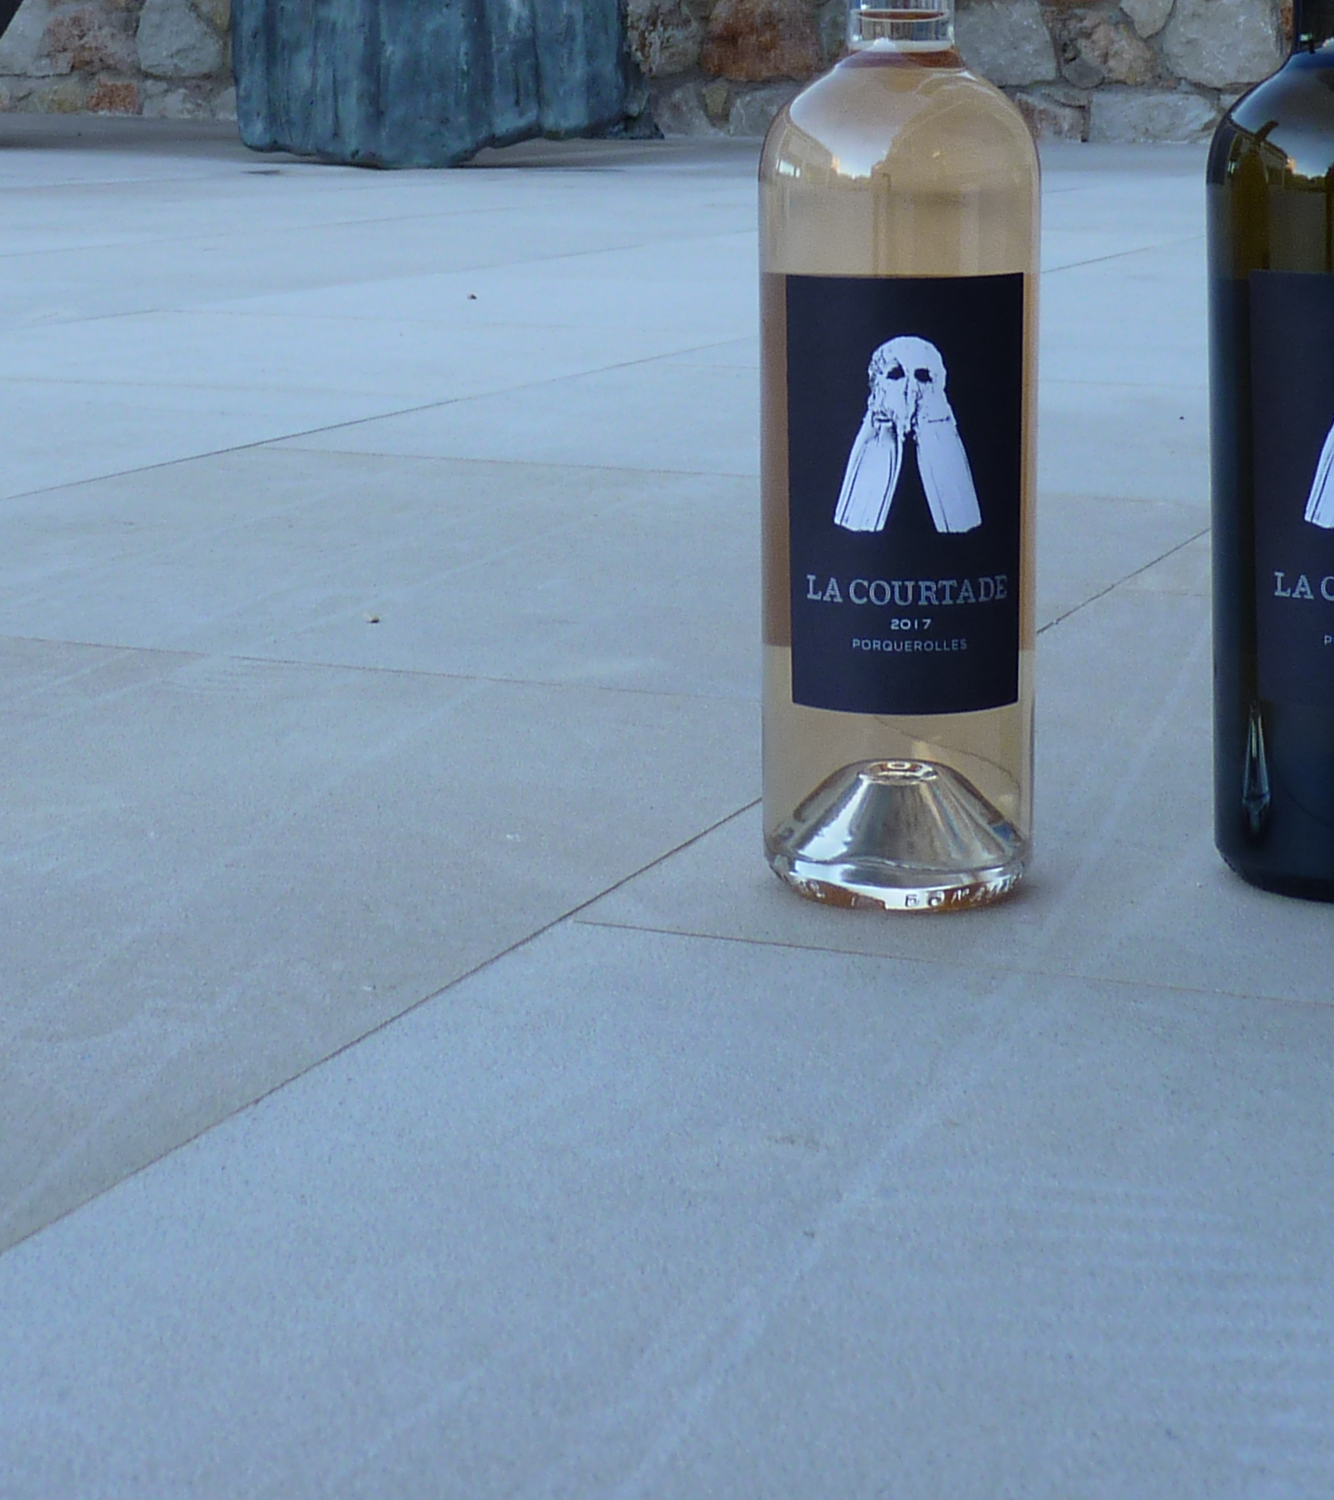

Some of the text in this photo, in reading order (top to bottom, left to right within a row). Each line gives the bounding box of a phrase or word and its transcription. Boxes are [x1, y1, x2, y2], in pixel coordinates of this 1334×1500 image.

[806, 574, 1007, 605] LA COURTADE
[1274, 571, 1314, 599] LA
[890, 618, 931, 630] 2017
[852, 638, 967, 651] PORQUEROLLES
